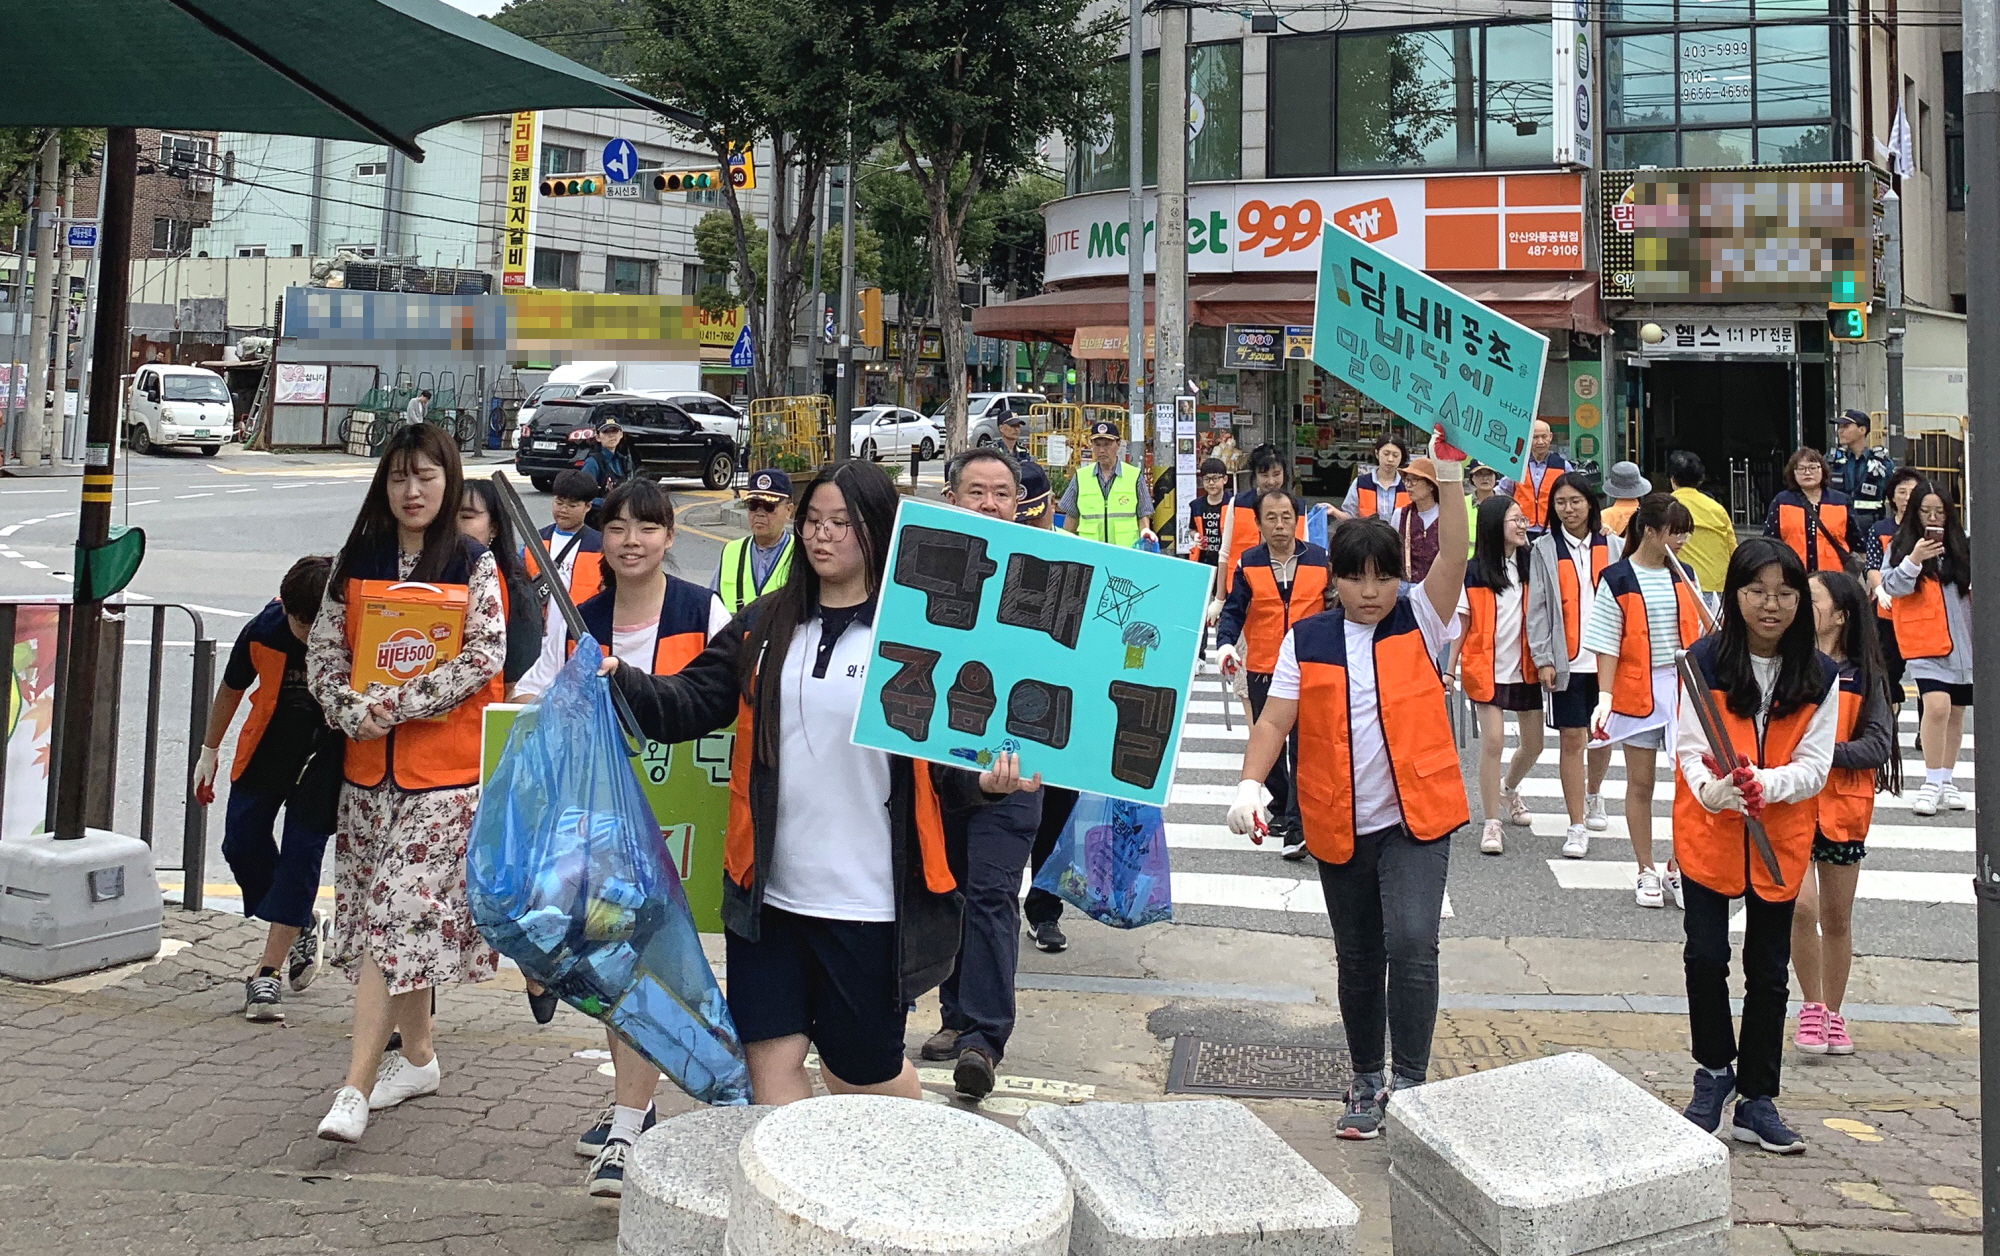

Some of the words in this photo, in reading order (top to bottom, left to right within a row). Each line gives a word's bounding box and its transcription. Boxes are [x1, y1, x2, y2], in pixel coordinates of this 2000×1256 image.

[1684, 42, 1748, 58] 403-5999
[1683, 71, 1710, 84] 010-
[1683, 85, 1749, 101] 9656-4656
[512, 167, 530, 181] 숯불
[733, 173, 744, 182] 30
[606, 185, 639, 198] 동시신호
[509, 185, 527, 267] 돼지갈비
[1048, 229, 1079, 256] LOTTE
[1087, 210, 1228, 259] Maret
[1237, 198, 1322, 258] 999
[1527, 245, 1579, 256] 487-9106
[1847, 310, 1863, 337] 9
[1675, 324, 1721, 347] 헬스
[1726, 328, 1744, 342] 1:1
[1751, 328, 1767, 342] PT
[1770, 327, 1792, 342] 전문
[1206, 520, 1218, 528] ON
[377, 643, 436, 669] 비타500
